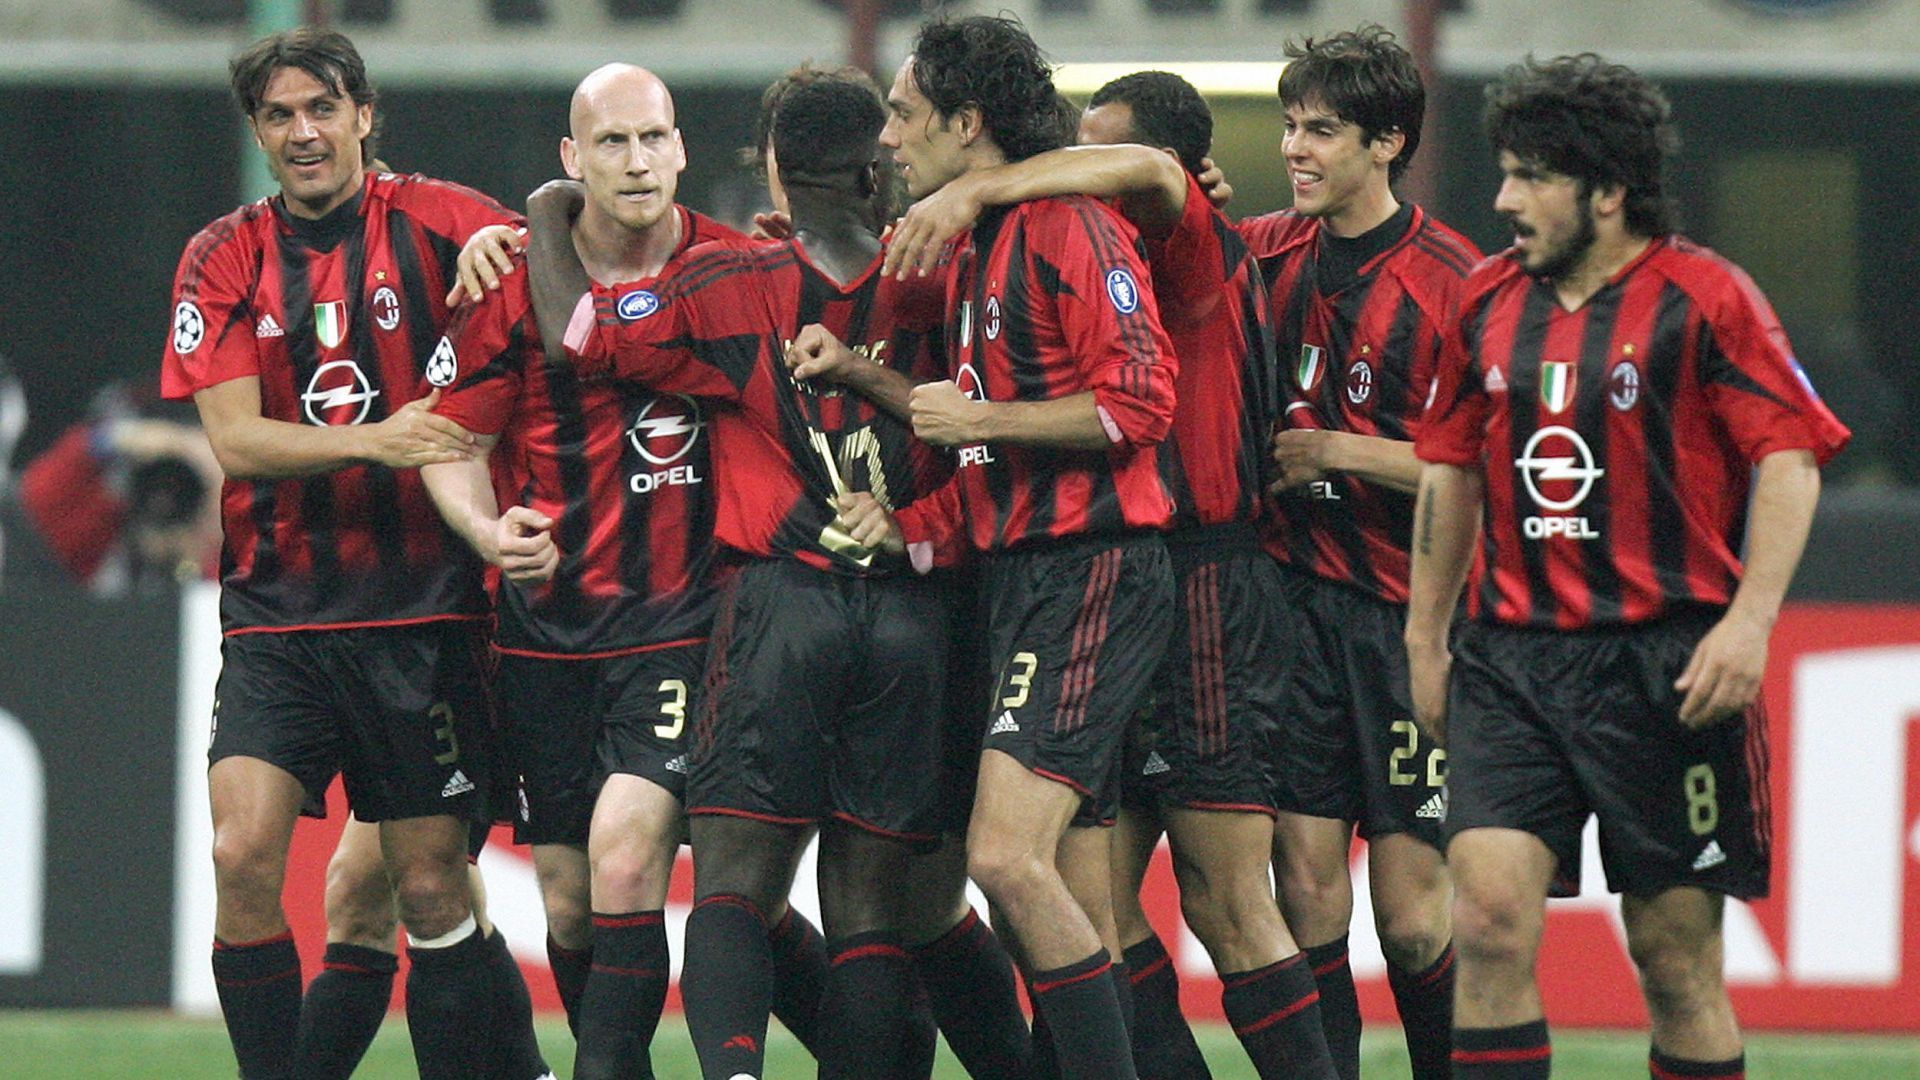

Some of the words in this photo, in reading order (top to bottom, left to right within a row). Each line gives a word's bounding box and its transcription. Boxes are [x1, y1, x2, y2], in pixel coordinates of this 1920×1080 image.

[958, 445, 995, 468] PEL
[630, 465, 703, 493] OPEL
[1523, 516, 1600, 539] OPEL
[654, 679, 687, 739] 3
[429, 701, 459, 765] 3
[1684, 763, 1719, 836] 8
